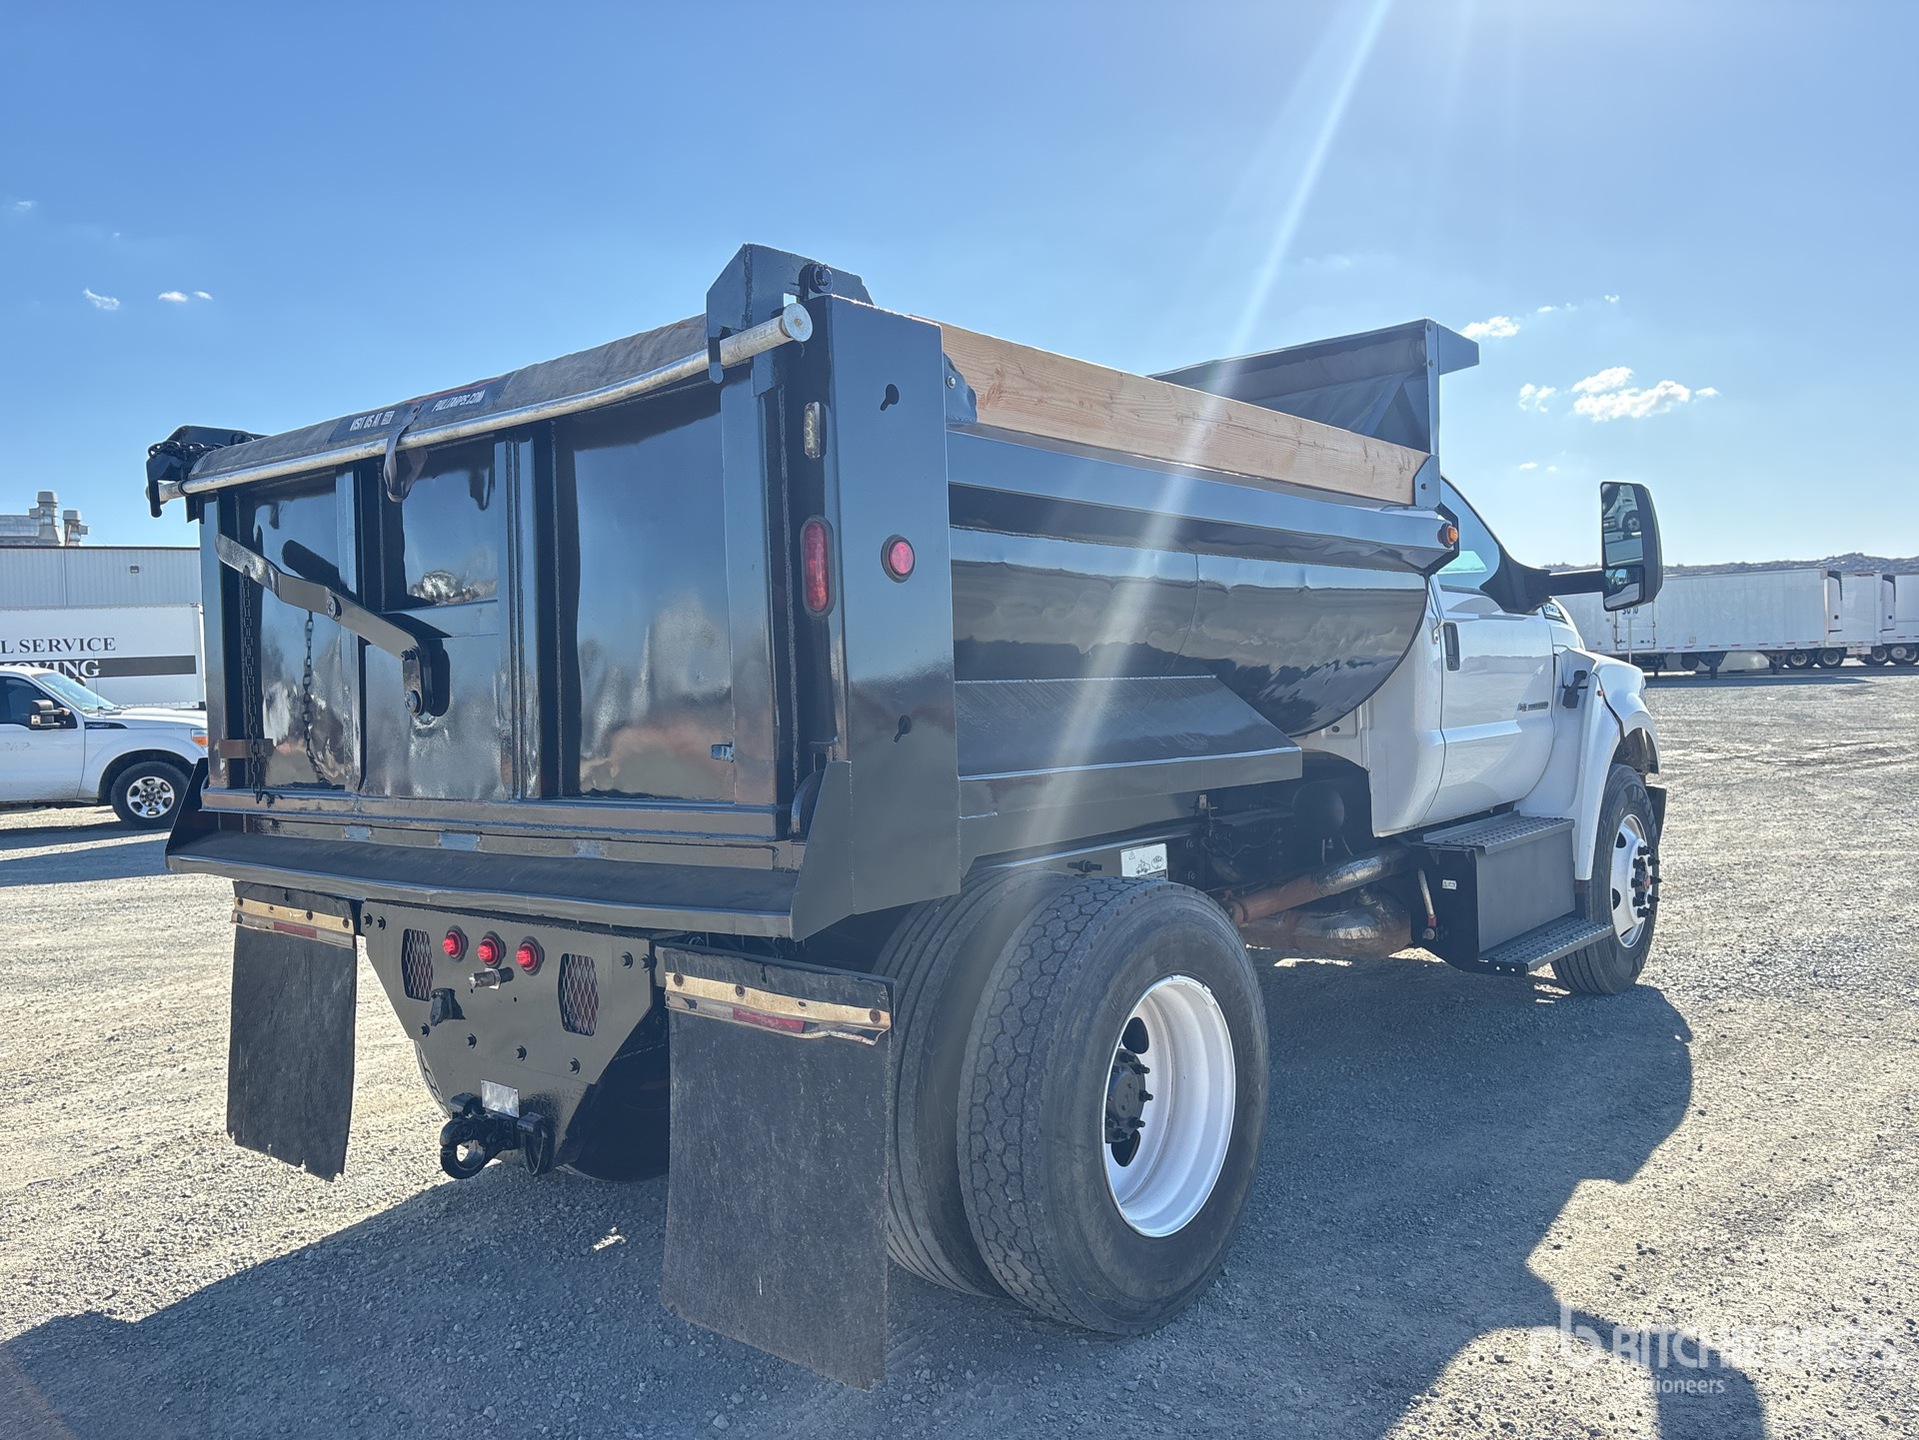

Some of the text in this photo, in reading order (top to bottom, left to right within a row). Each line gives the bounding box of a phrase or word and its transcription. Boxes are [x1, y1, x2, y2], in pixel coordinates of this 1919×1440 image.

[350, 416, 366, 431] VISIT
[19, 637, 116, 653] SERVICE
[2, 659, 101, 677] ING
